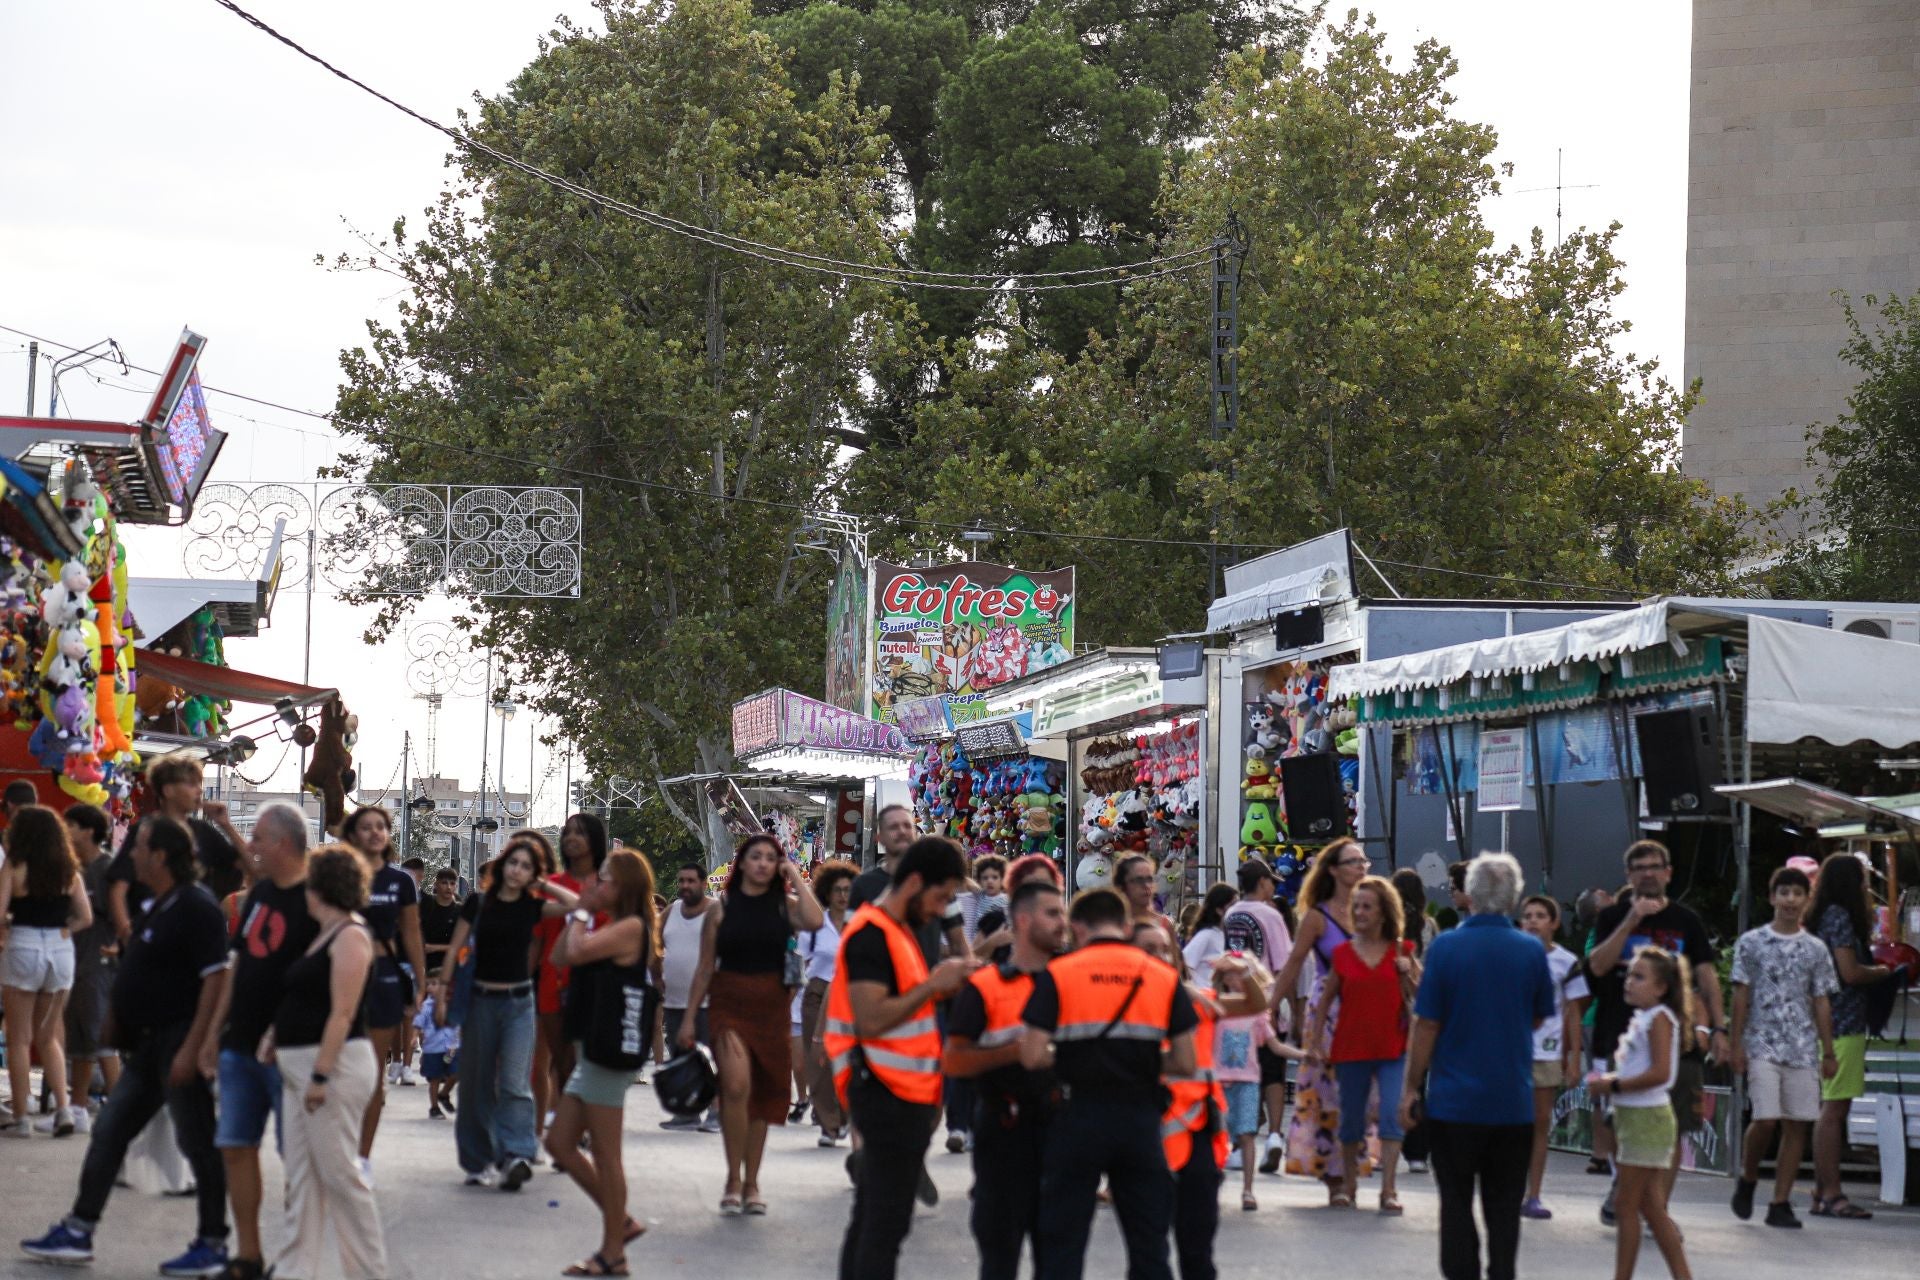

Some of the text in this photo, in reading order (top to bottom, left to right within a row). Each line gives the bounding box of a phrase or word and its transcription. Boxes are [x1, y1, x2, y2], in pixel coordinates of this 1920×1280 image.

[883, 574, 1028, 624] Gofres
[879, 617, 939, 633] Buñuelos
[880, 642, 920, 654] nutella
[946, 692, 985, 704] Crepe
